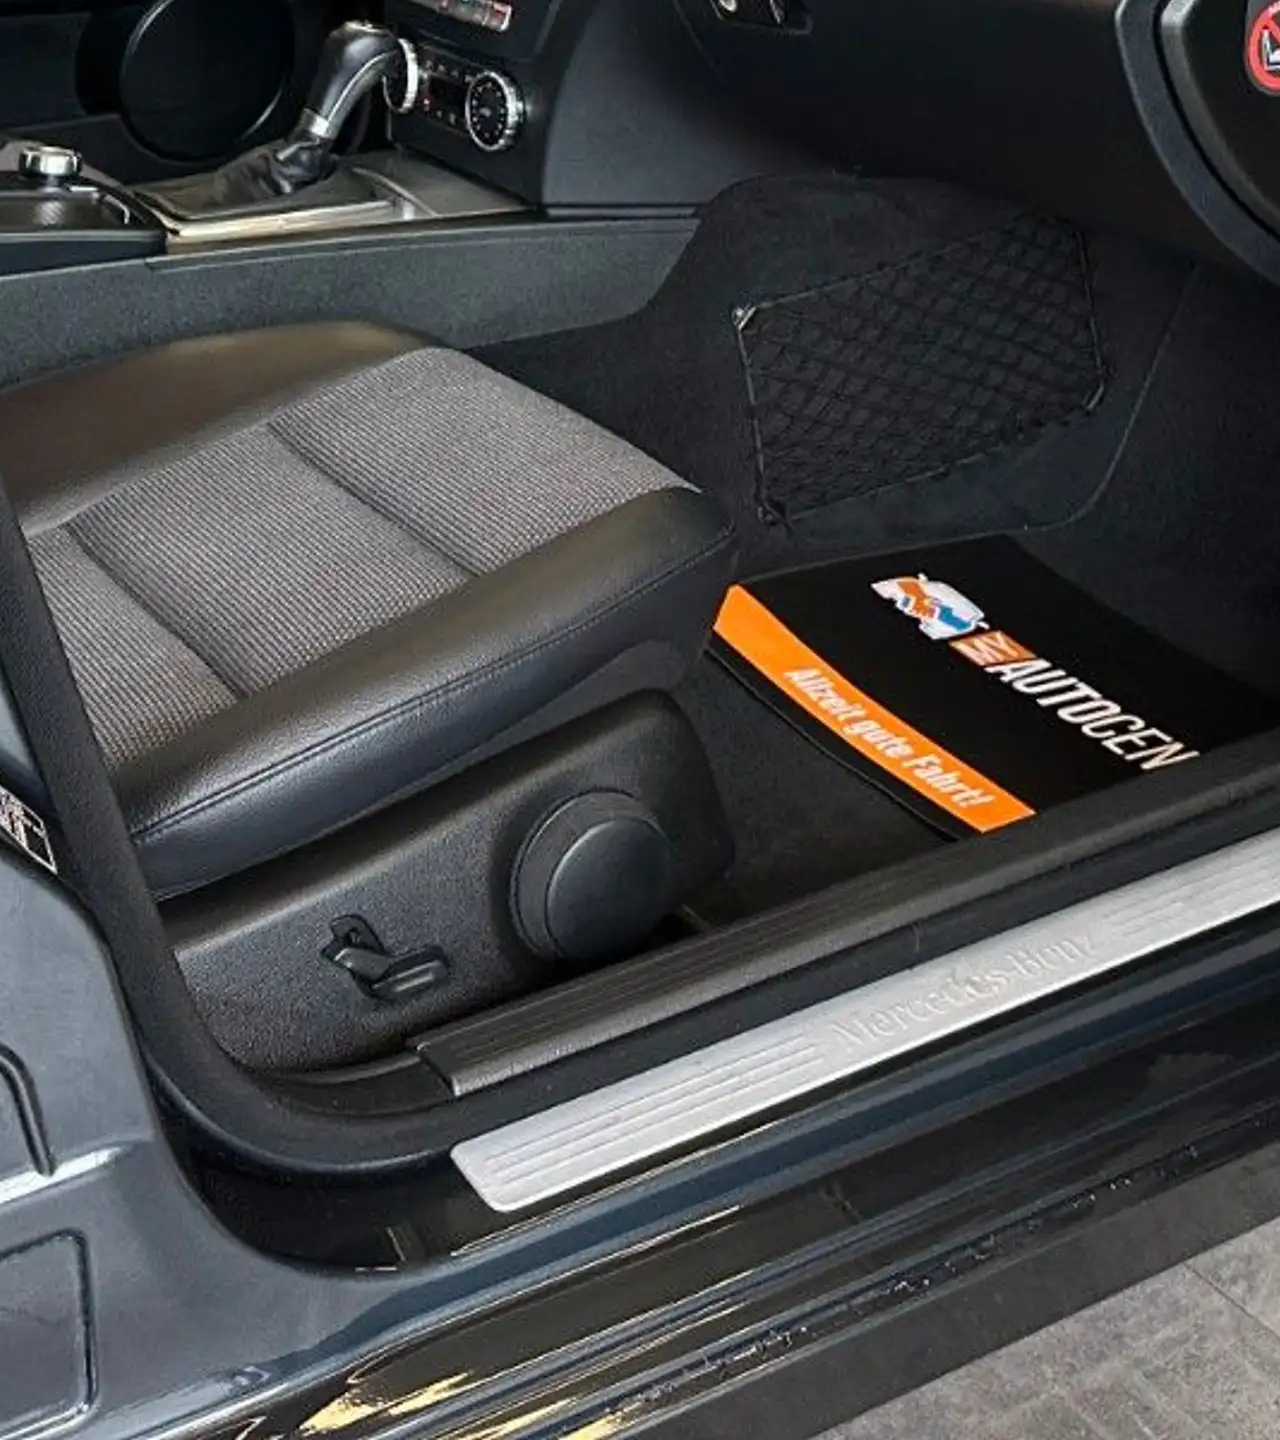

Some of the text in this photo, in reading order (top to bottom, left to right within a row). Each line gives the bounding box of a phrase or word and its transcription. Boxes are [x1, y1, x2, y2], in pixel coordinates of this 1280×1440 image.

[784, 667, 996, 808] Allzeit gute Fahrt!
[833, 932, 1099, 1050] Mercedes-Benz
